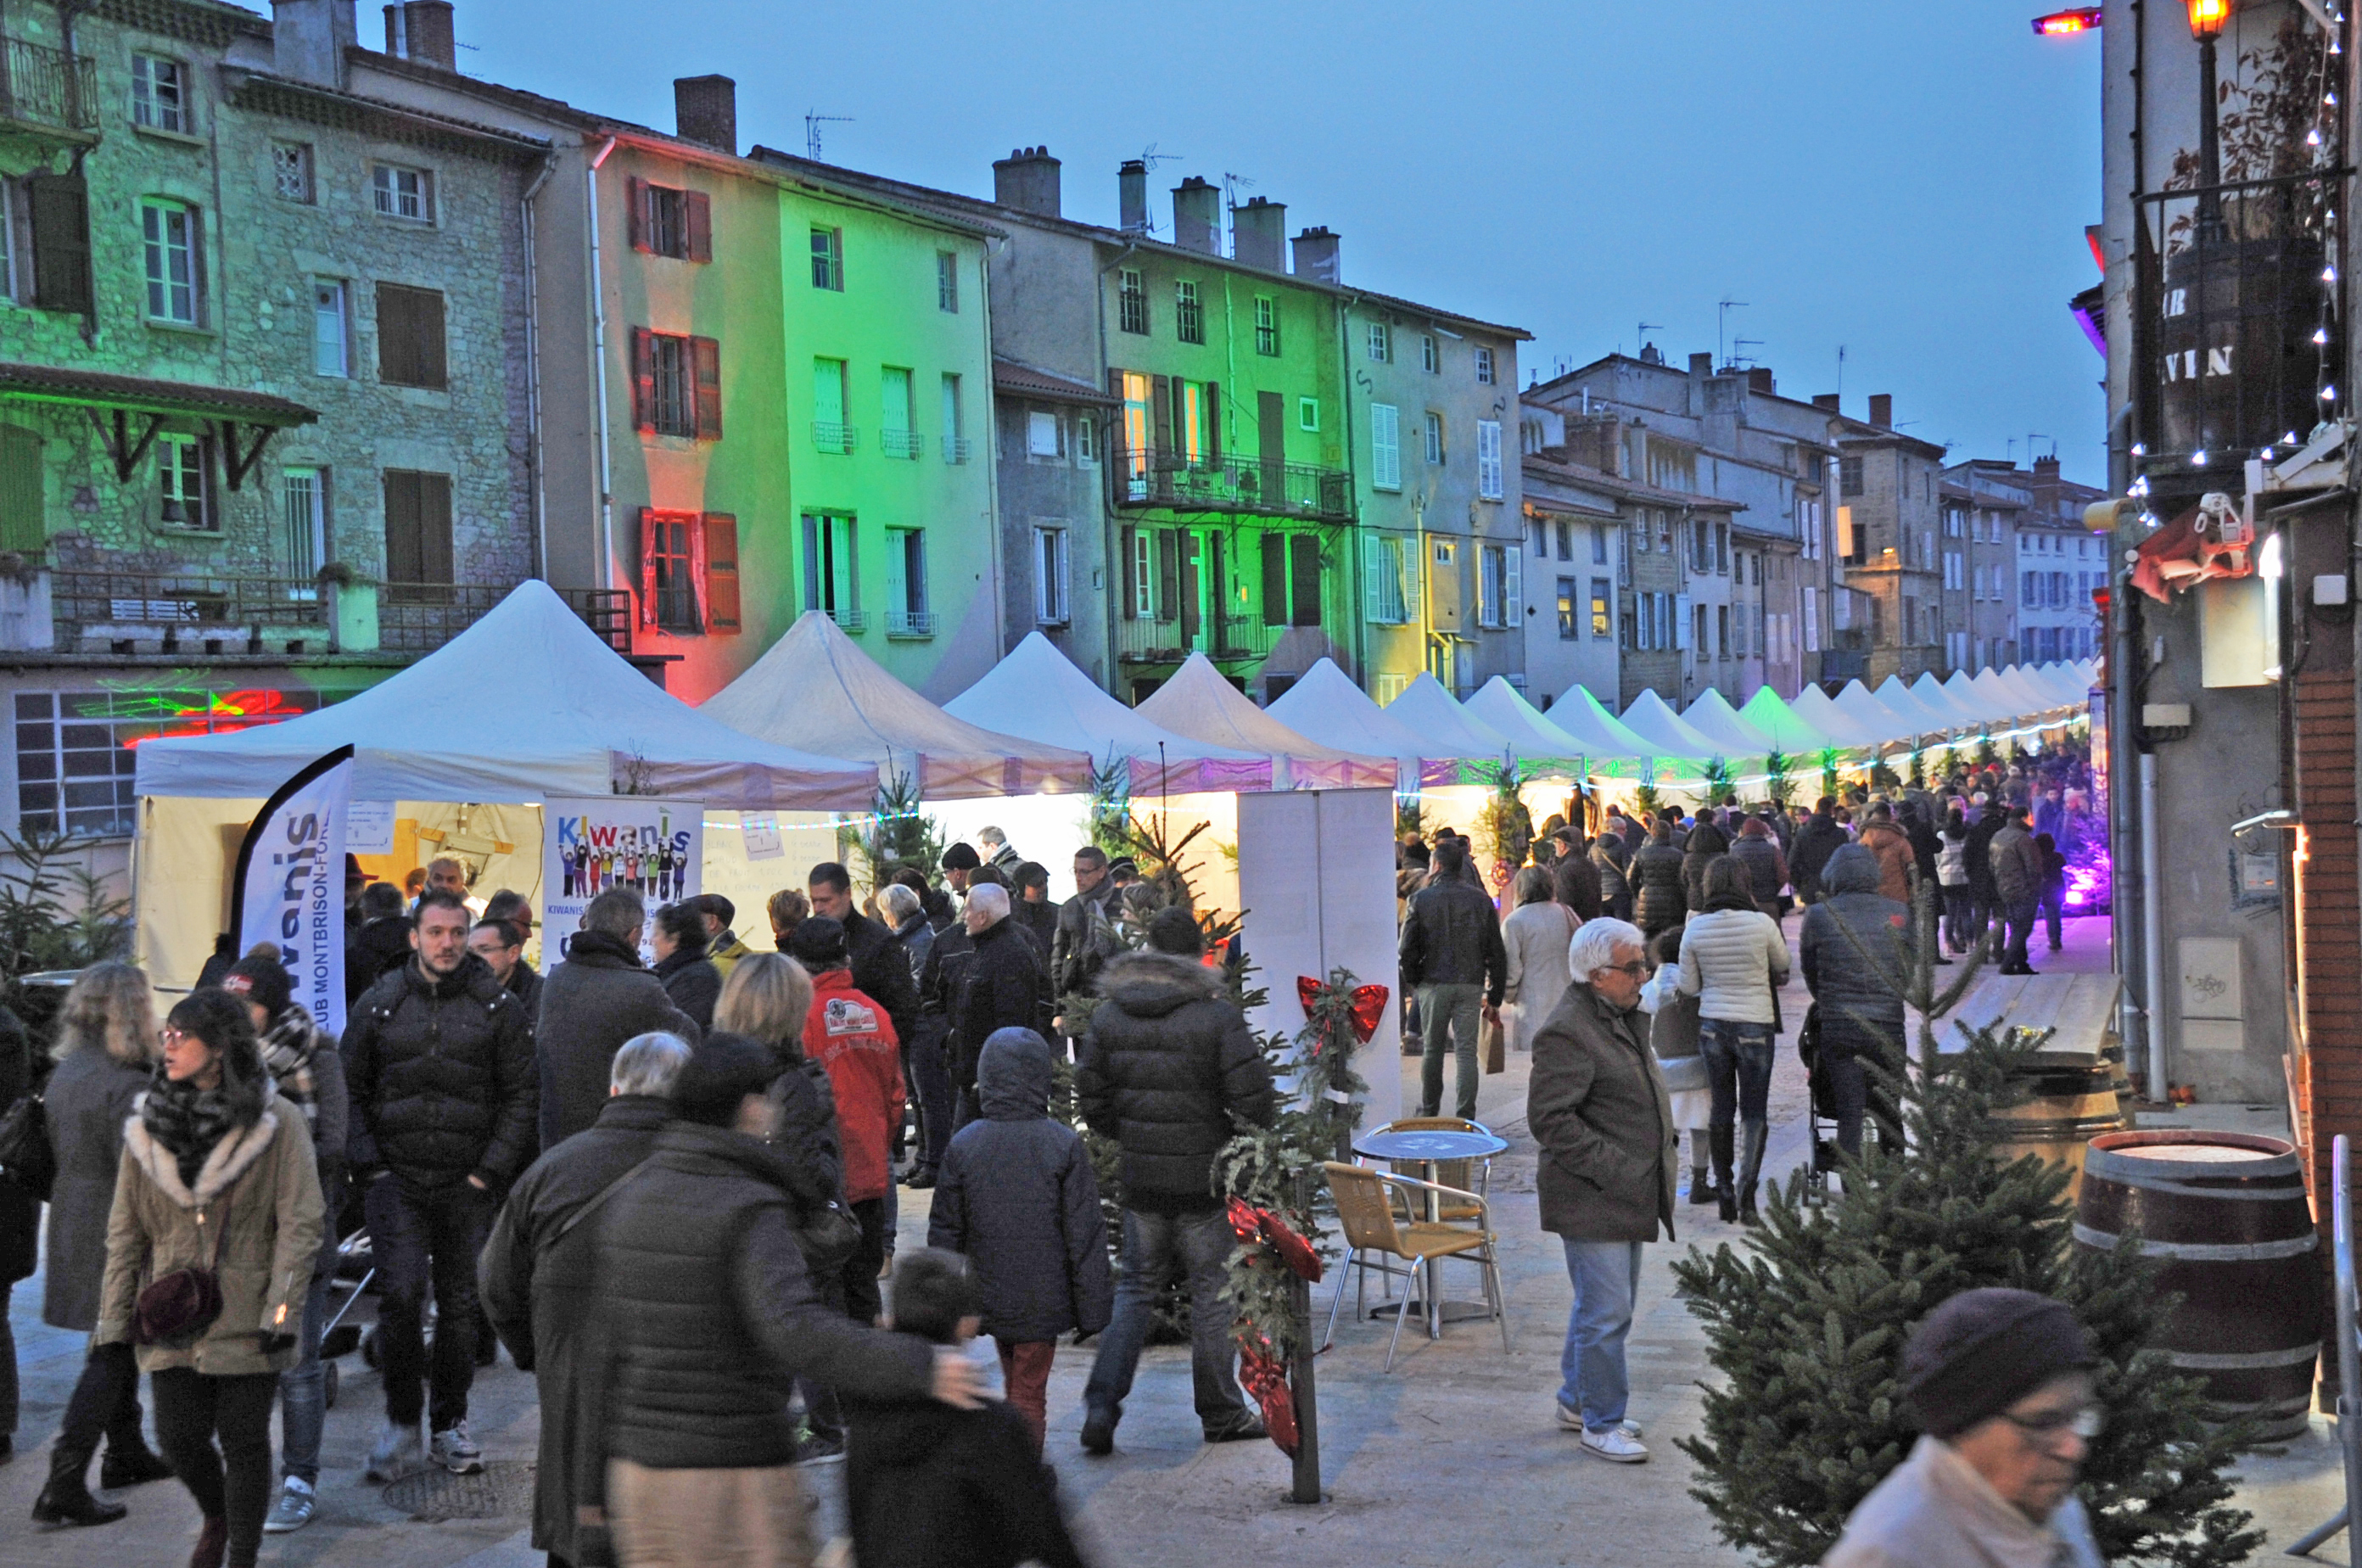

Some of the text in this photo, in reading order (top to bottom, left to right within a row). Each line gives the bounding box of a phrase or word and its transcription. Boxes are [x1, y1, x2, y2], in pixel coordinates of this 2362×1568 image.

[2166, 346, 2233, 382] VIN
[558, 812, 691, 852] Kiwanis
[547, 904, 584, 916] KIWANIS
